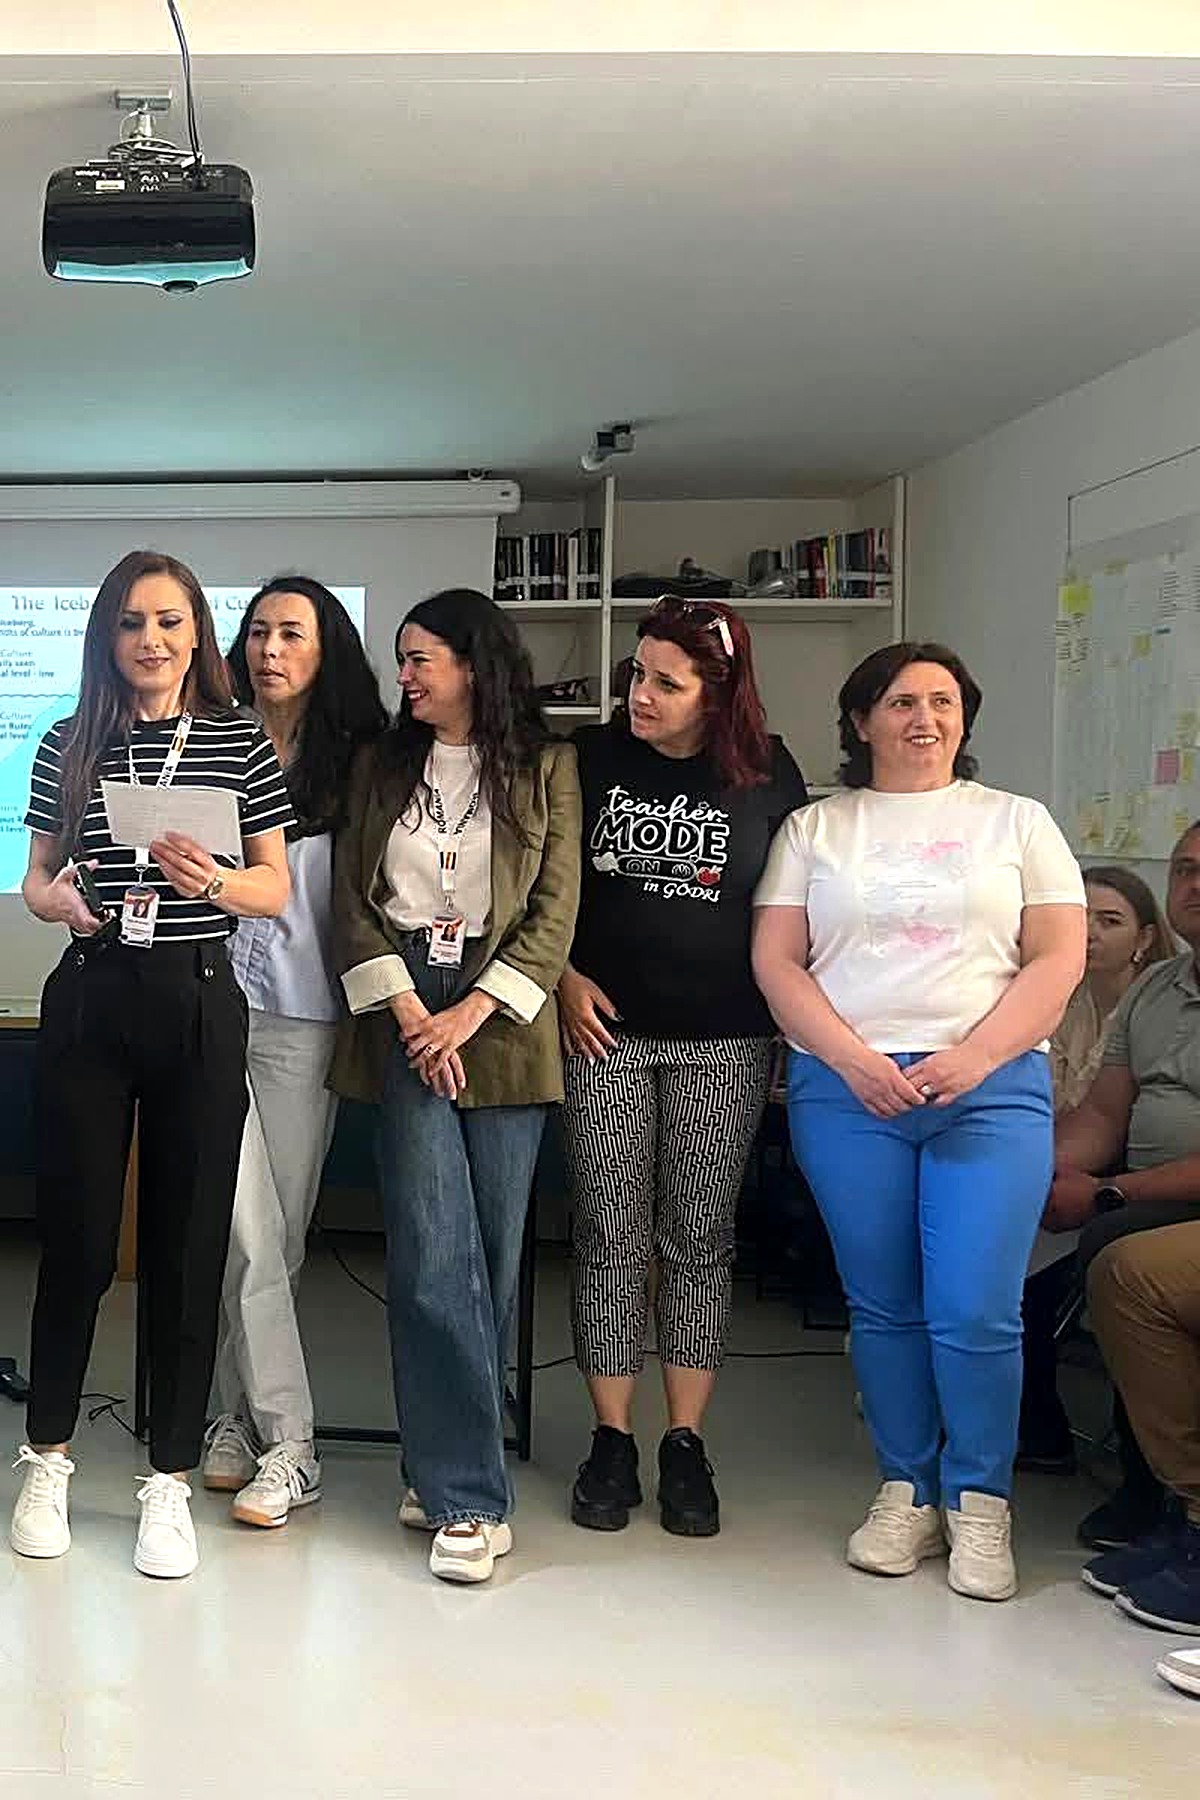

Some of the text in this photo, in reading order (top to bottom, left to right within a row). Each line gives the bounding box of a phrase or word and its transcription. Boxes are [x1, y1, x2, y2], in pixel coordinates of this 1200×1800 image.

[11, 594, 45, 611] The
[54, 594, 90, 611] Iceb
[225, 595, 250, 611] Cu
[606, 785, 730, 822] teacher
[590, 812, 730, 865] MODE
[625, 858, 661, 874] ON
[643, 880, 659, 892] in
